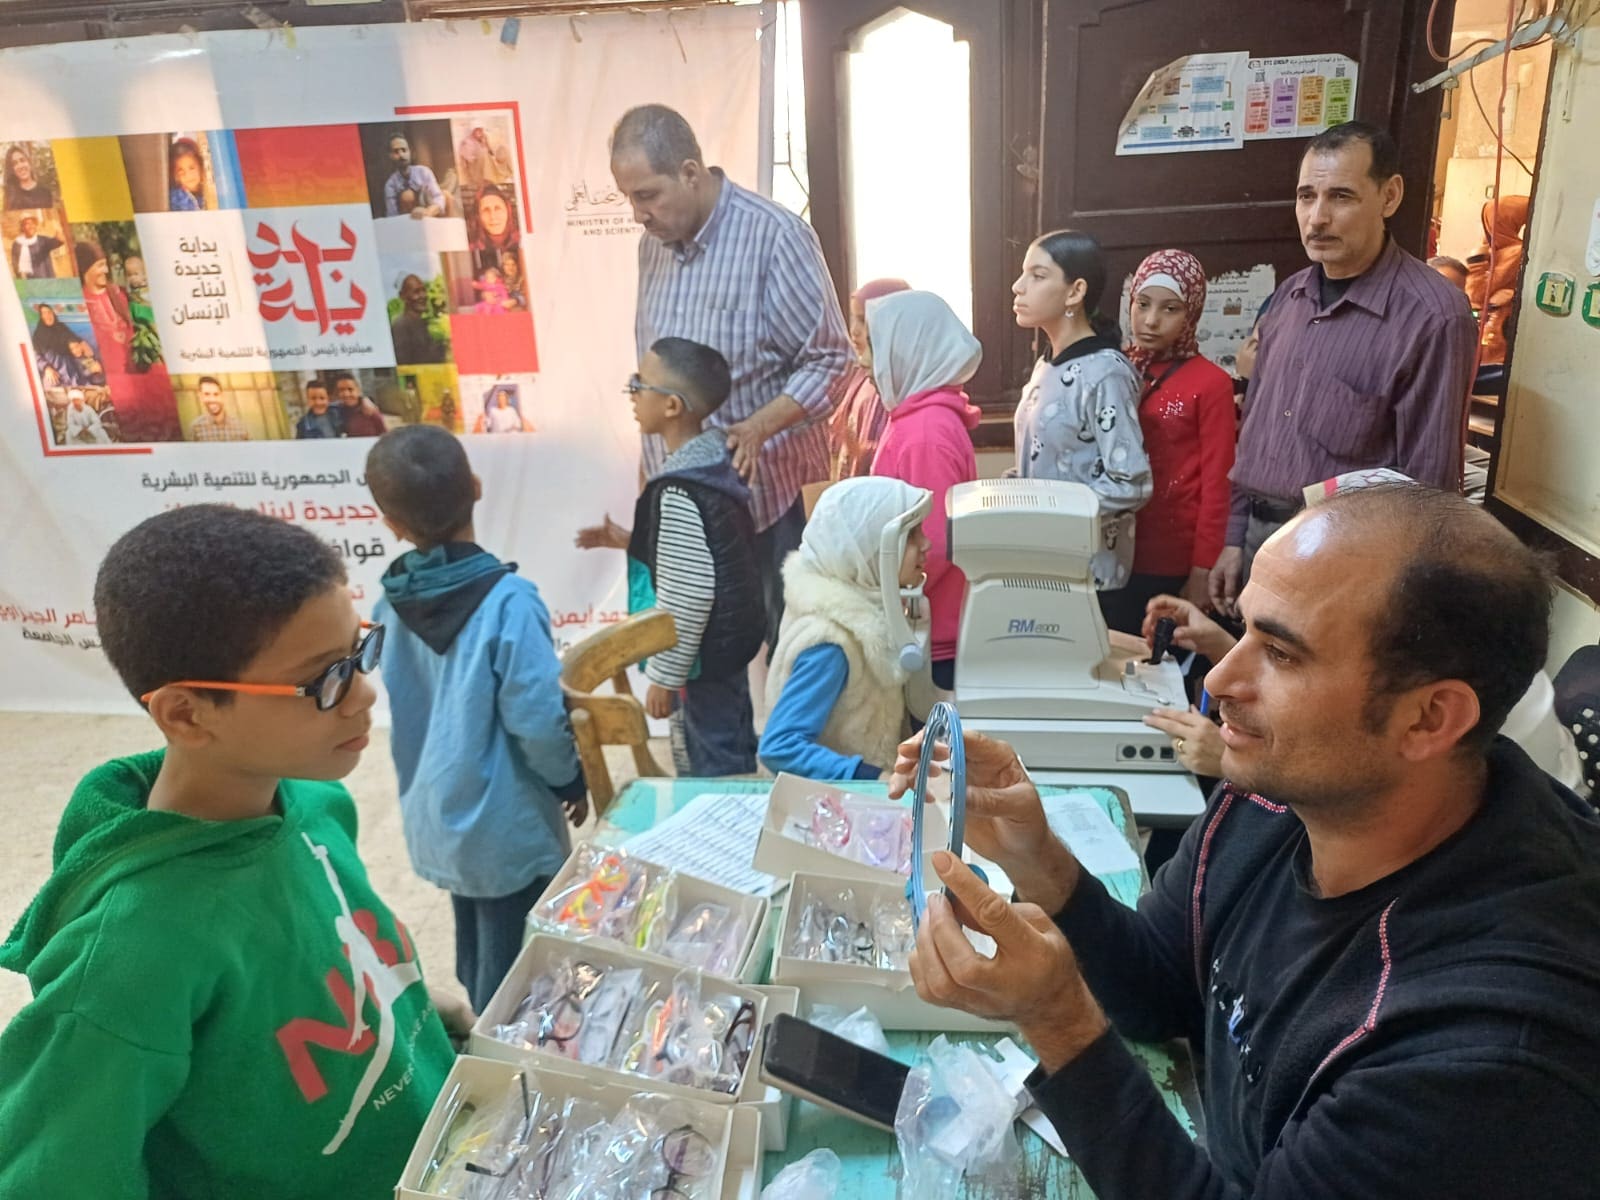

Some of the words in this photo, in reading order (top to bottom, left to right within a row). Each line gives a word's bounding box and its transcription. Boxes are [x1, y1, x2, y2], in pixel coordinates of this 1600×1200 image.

[179, 235, 217, 258] بداية
[174, 259, 222, 280] جديدة
[191, 280, 227, 302] لبناء
[171, 301, 231, 326] الإنسان
[256, 345, 308, 360] الجمهورية
[311, 343, 338, 357] رئيس
[141, 470, 199, 492] البشرية
[203, 472, 257, 491] للتنمية
[261, 469, 351, 490] الجمهورية
[304, 500, 377, 525] جديدة
[552, 603, 594, 629] أيمن
